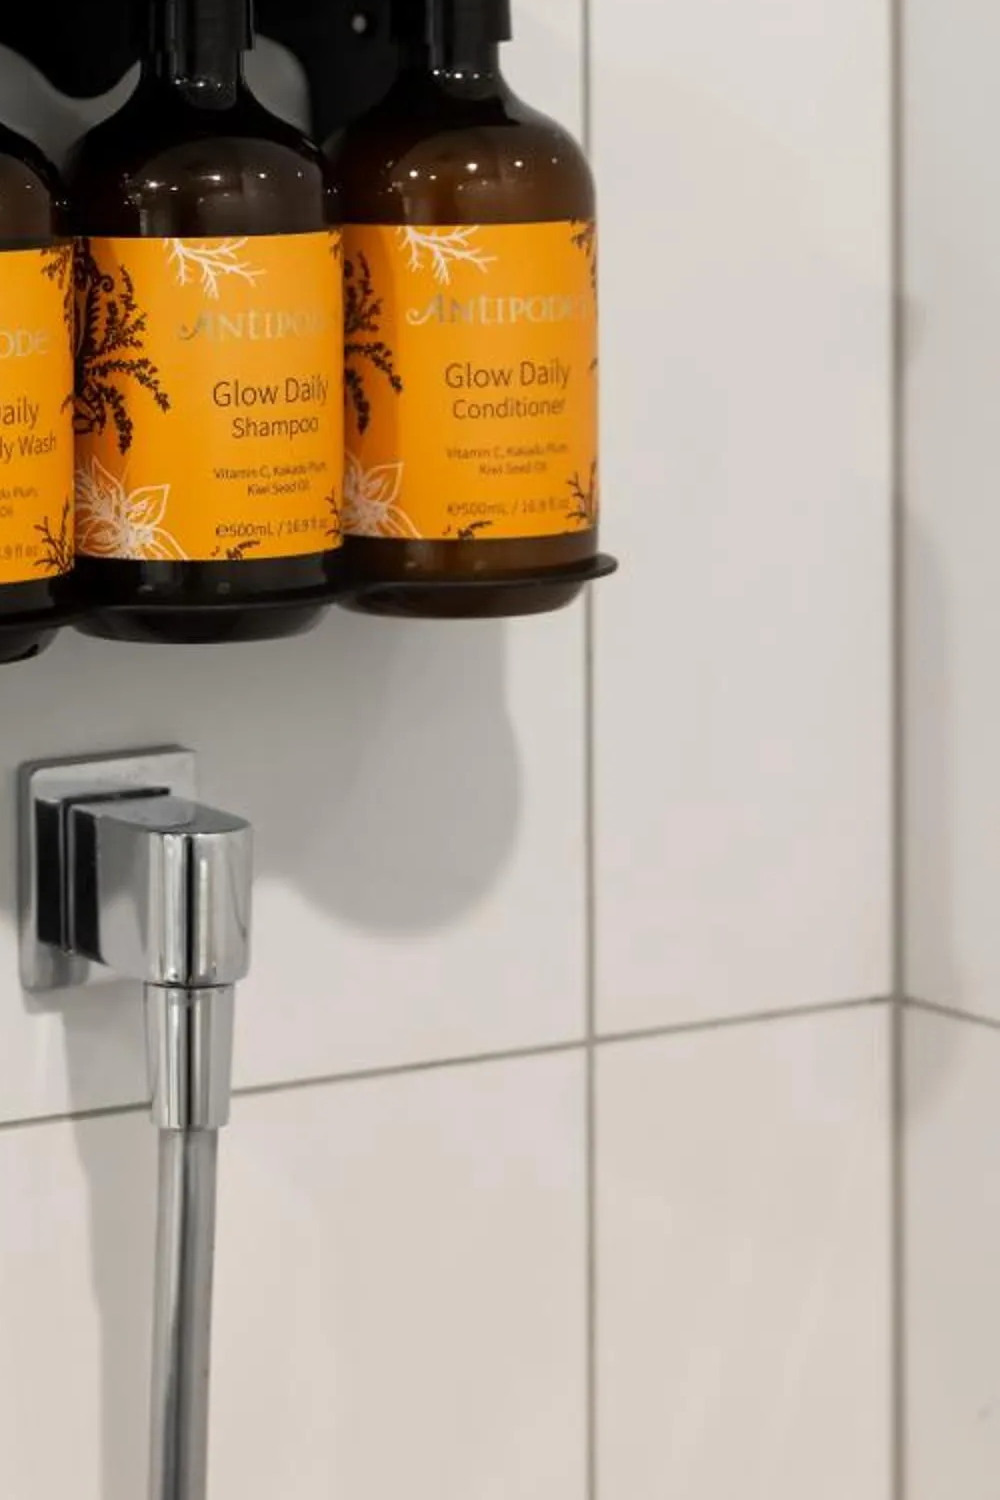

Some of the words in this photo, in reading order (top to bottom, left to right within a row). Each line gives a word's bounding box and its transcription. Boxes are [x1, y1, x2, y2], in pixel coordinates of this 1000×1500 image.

[445, 361, 513, 389] Glow
[520, 357, 570, 388] Daily
[213, 378, 278, 408] Glow
[285, 373, 329, 407] Daily
[453, 396, 566, 420] Conditioner
[232, 415, 319, 441] Shampoo
[17, 434, 57, 457] Wash
